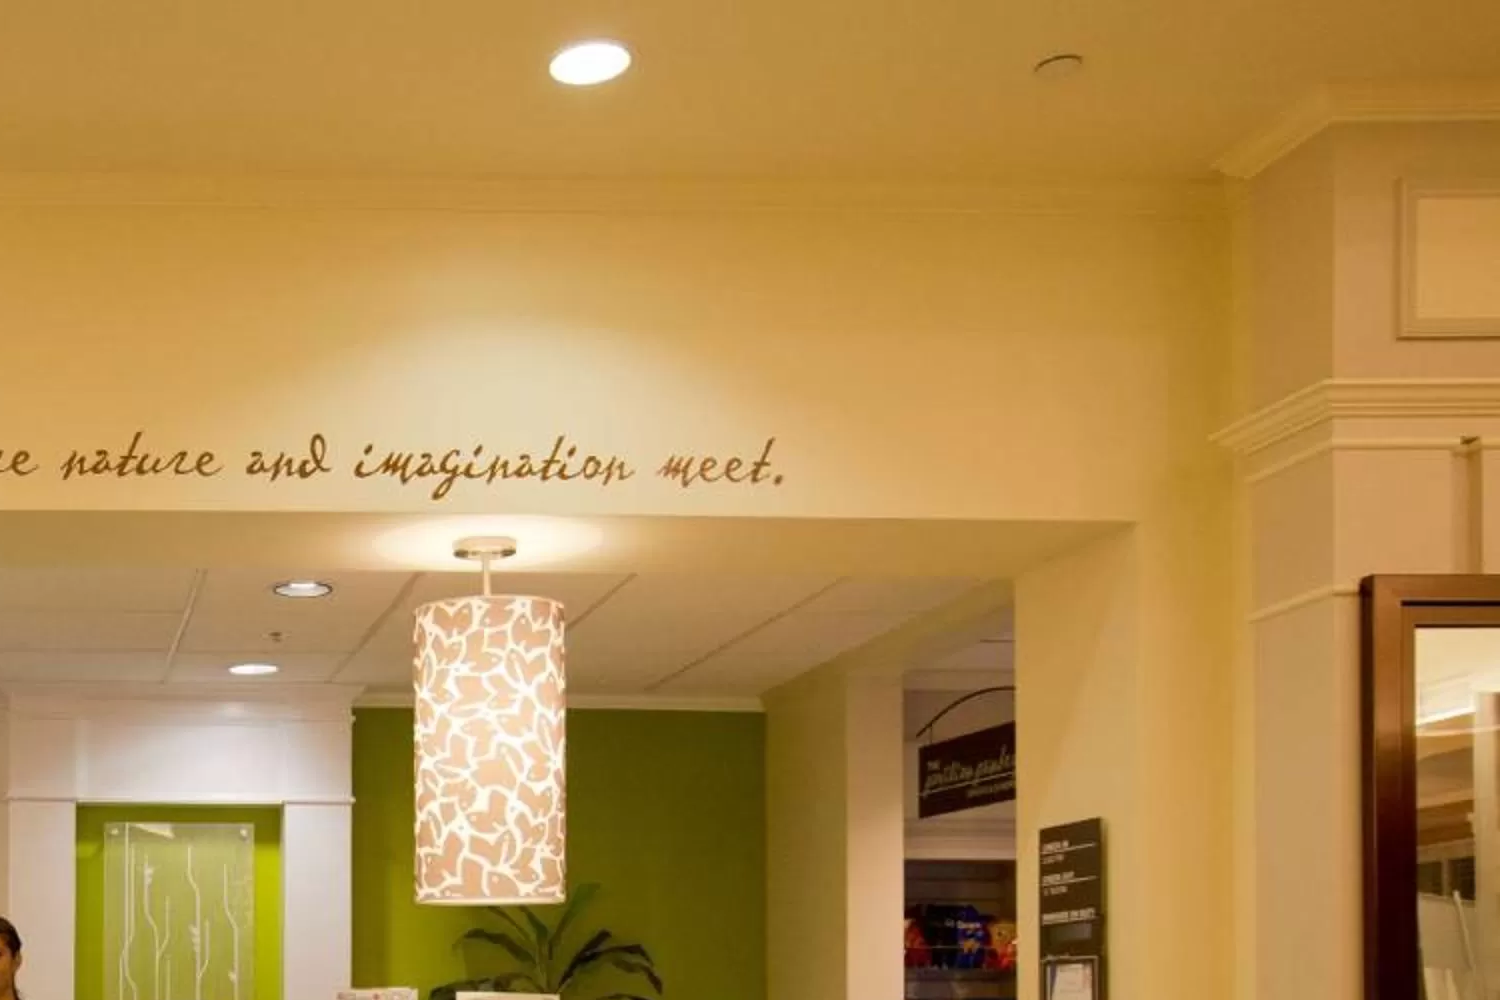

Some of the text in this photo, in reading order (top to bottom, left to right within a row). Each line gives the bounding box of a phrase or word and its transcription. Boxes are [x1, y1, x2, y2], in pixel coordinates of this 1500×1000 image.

[59, 431, 223, 481] nature
[245, 432, 332, 483] and
[354, 435, 636, 501] imagination
[656, 436, 785, 488] meet.
